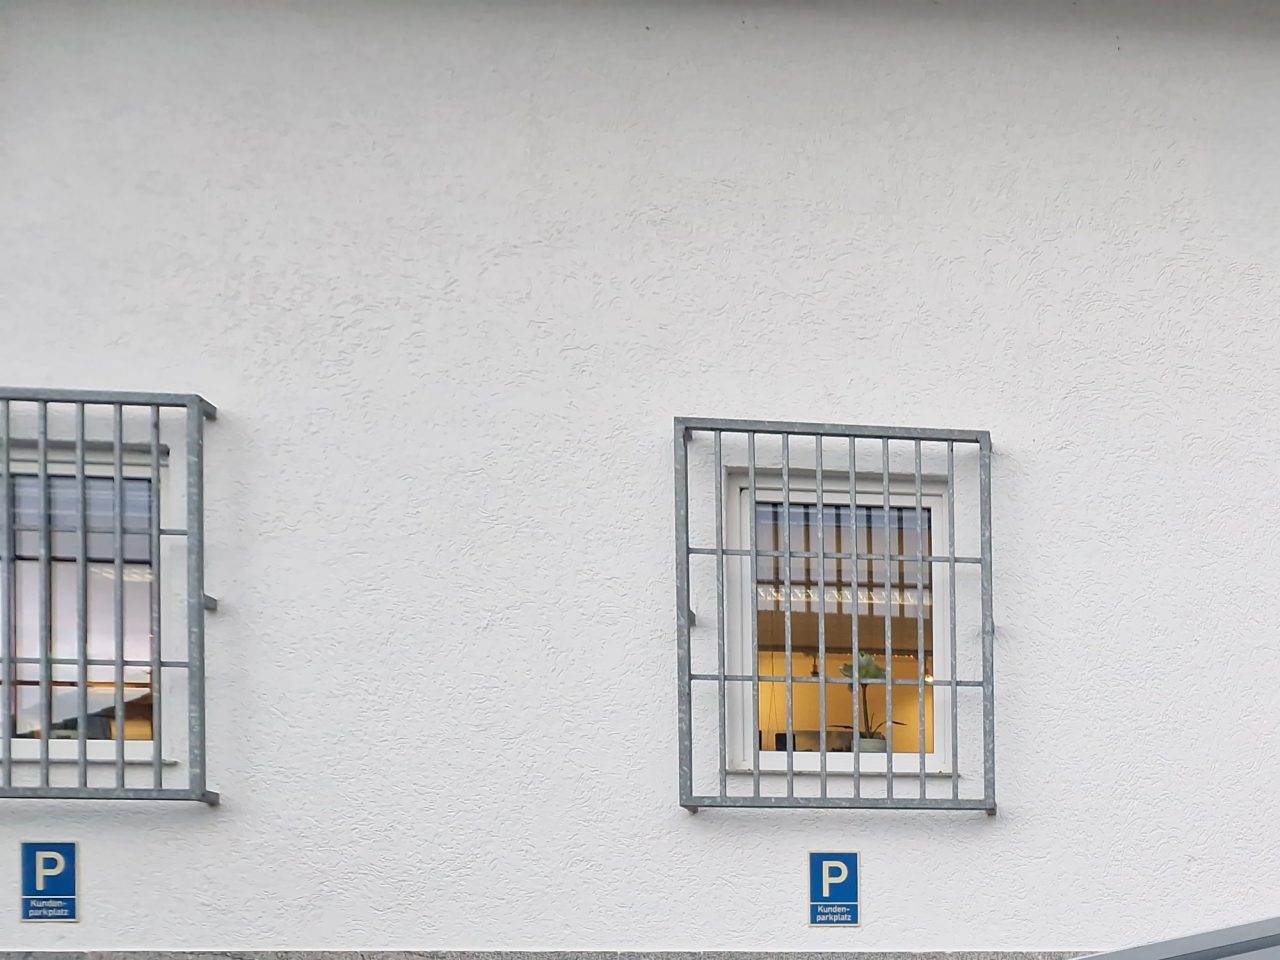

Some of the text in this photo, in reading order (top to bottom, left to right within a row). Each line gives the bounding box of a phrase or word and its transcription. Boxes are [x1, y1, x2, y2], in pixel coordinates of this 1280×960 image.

[35, 850, 66, 891] P
[822, 860, 849, 898] P
[30, 899, 68, 908] Kunden-
[817, 904, 851, 913] Kunden-
[28, 908, 70, 918] parkplatz
[816, 913, 852, 923] parkplatz
